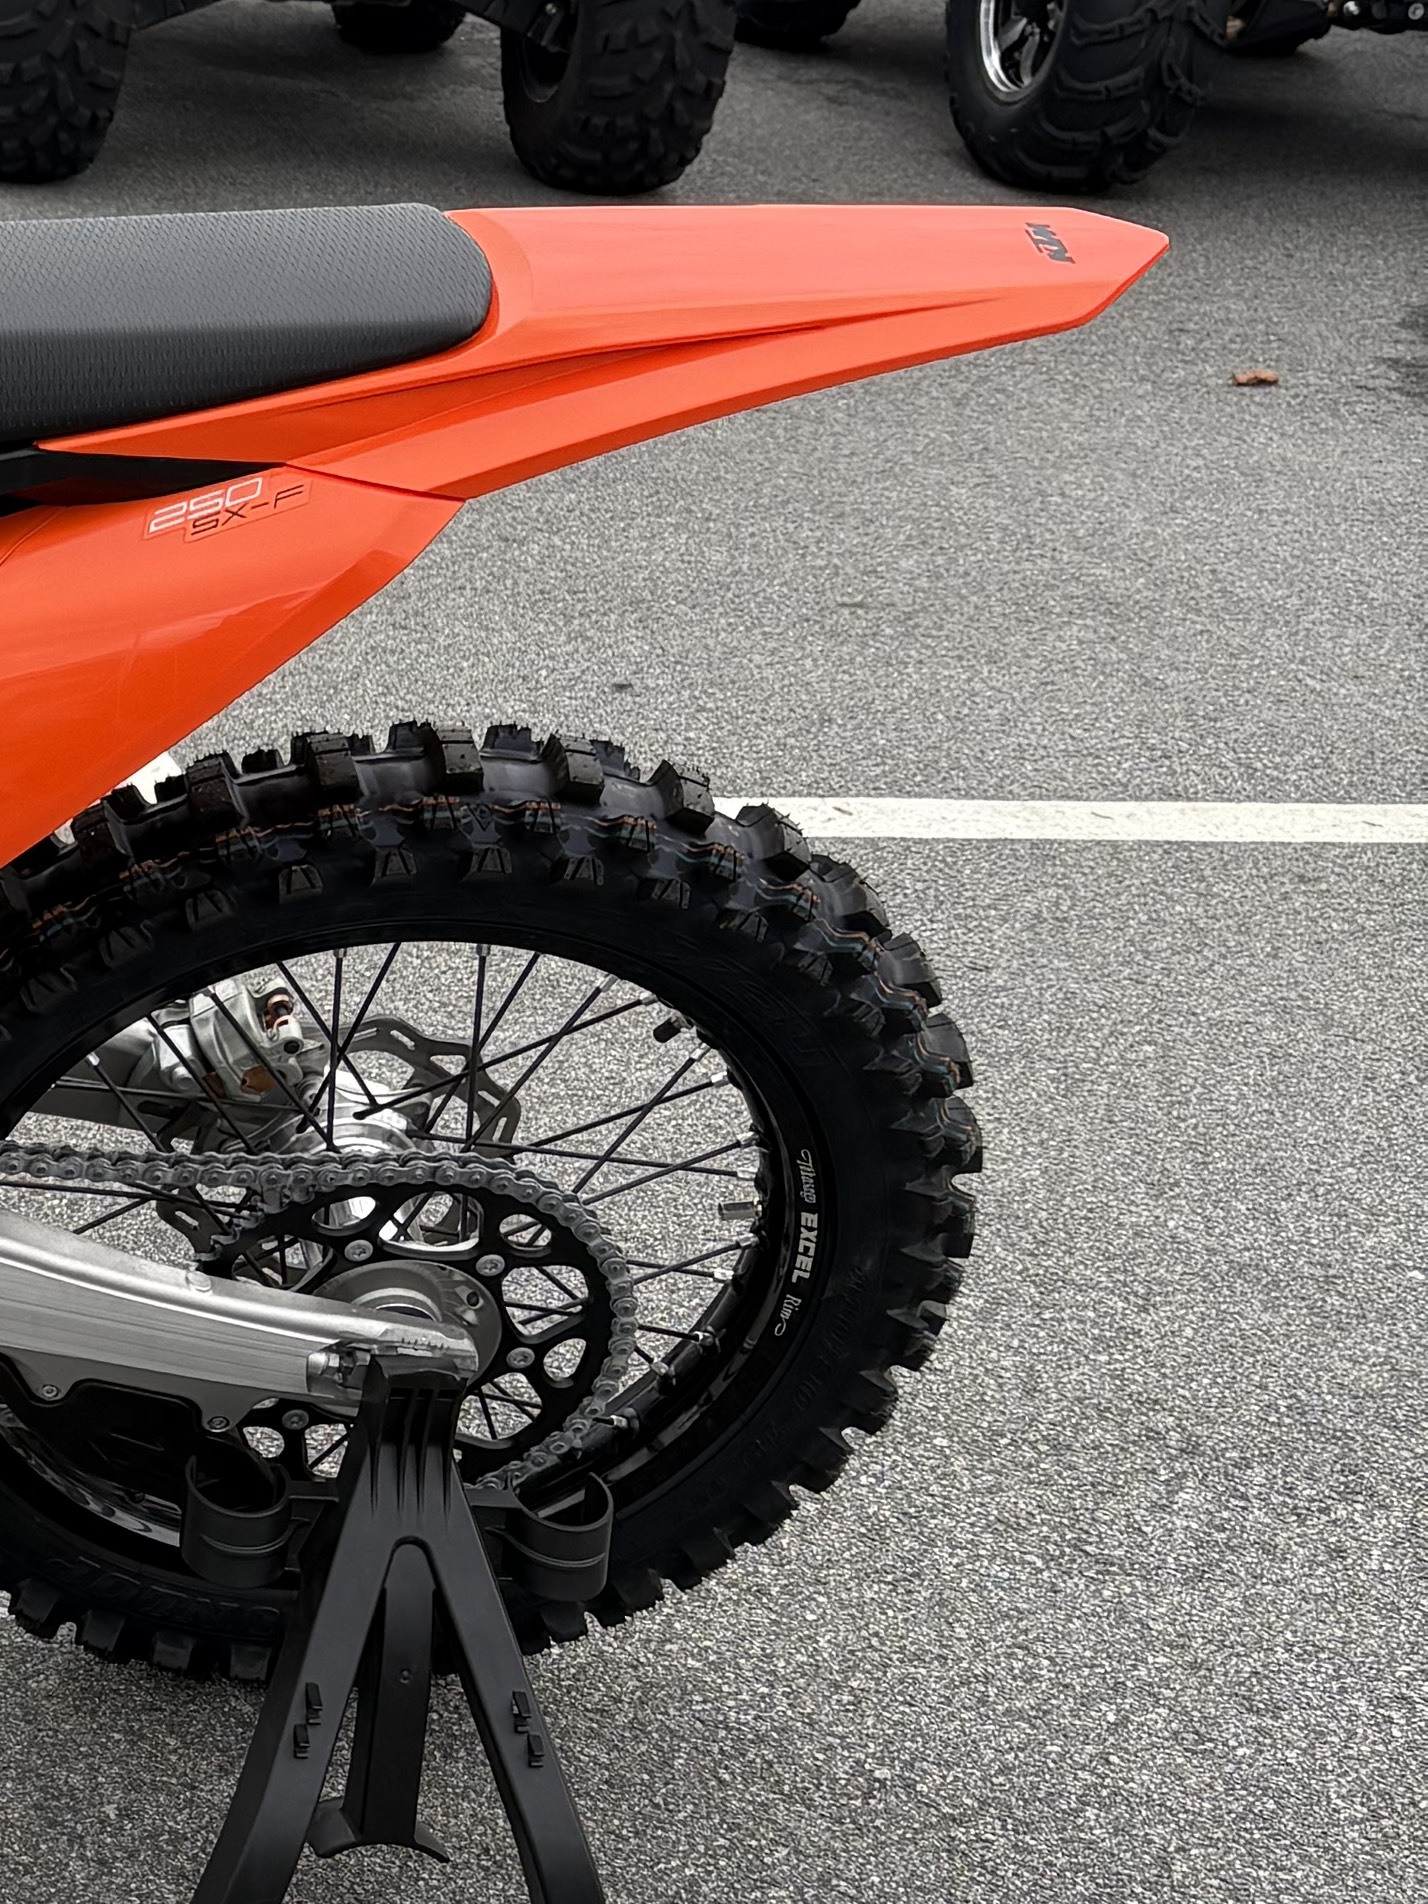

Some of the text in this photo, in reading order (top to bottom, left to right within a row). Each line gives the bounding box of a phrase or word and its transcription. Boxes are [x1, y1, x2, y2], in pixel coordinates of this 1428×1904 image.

[148, 477, 263, 533] 250
[191, 484, 305, 535] SX-F
[791, 1212, 818, 1283] EXCEL
[774, 1294, 802, 1337] Rim
